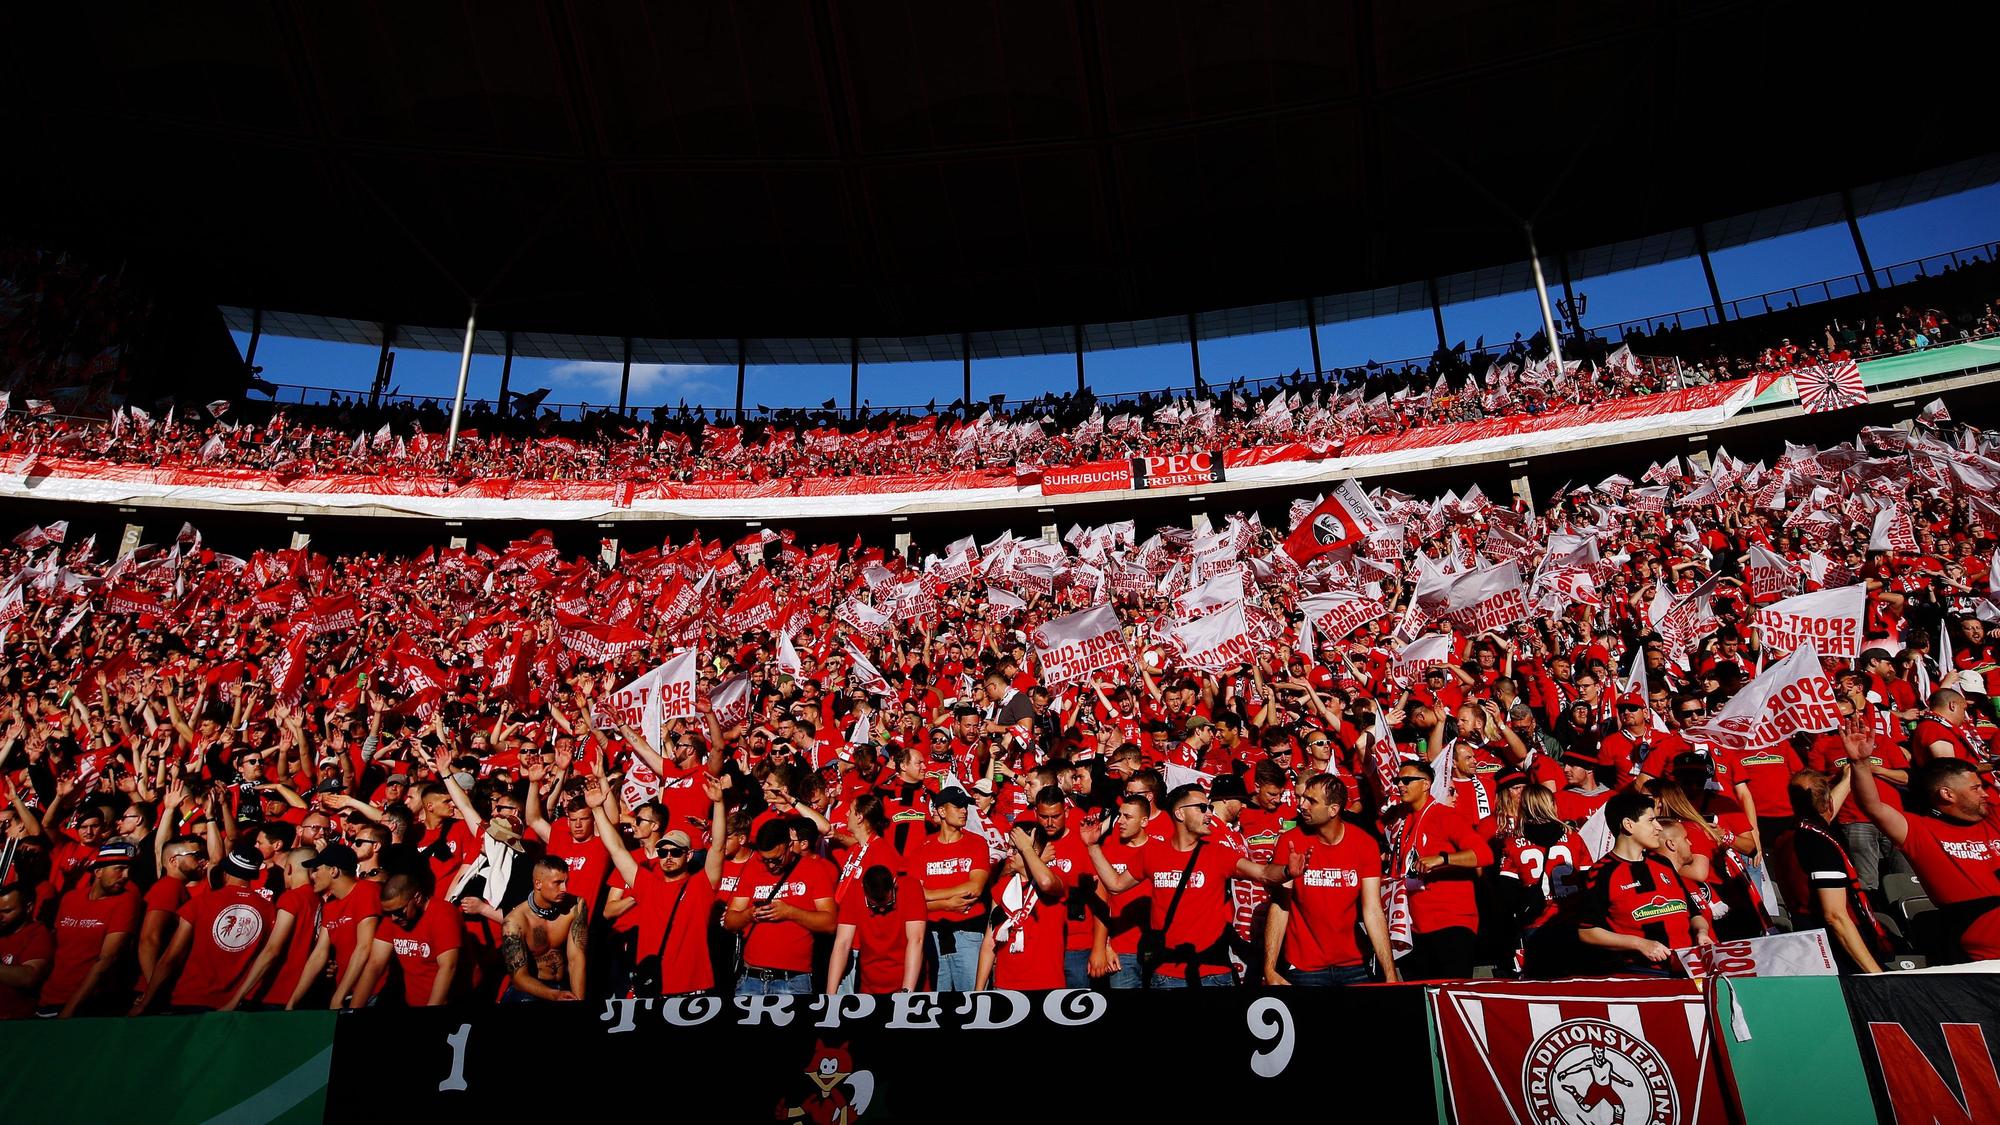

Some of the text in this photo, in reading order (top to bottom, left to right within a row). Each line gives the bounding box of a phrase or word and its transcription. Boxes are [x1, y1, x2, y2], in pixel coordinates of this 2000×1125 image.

[1144, 452, 1214, 477] PEC
[1043, 470, 1129, 486] SUHR/BUCHS
[1144, 472, 1218, 487] FREIBURG
[1326, 604, 1382, 640] FREIBURG
[926, 859, 958, 870] SPORT-CLUB
[1303, 869, 1341, 880] SPORT-CLUB
[1303, 877, 1334, 887] FREIBURG
[600, 988, 1108, 1034] TORPEDO
[1246, 997, 1296, 1077] 9
[438, 1023, 472, 1091] 1
[1531, 1024, 1672, 1115] TRADITIONSVEREIN
